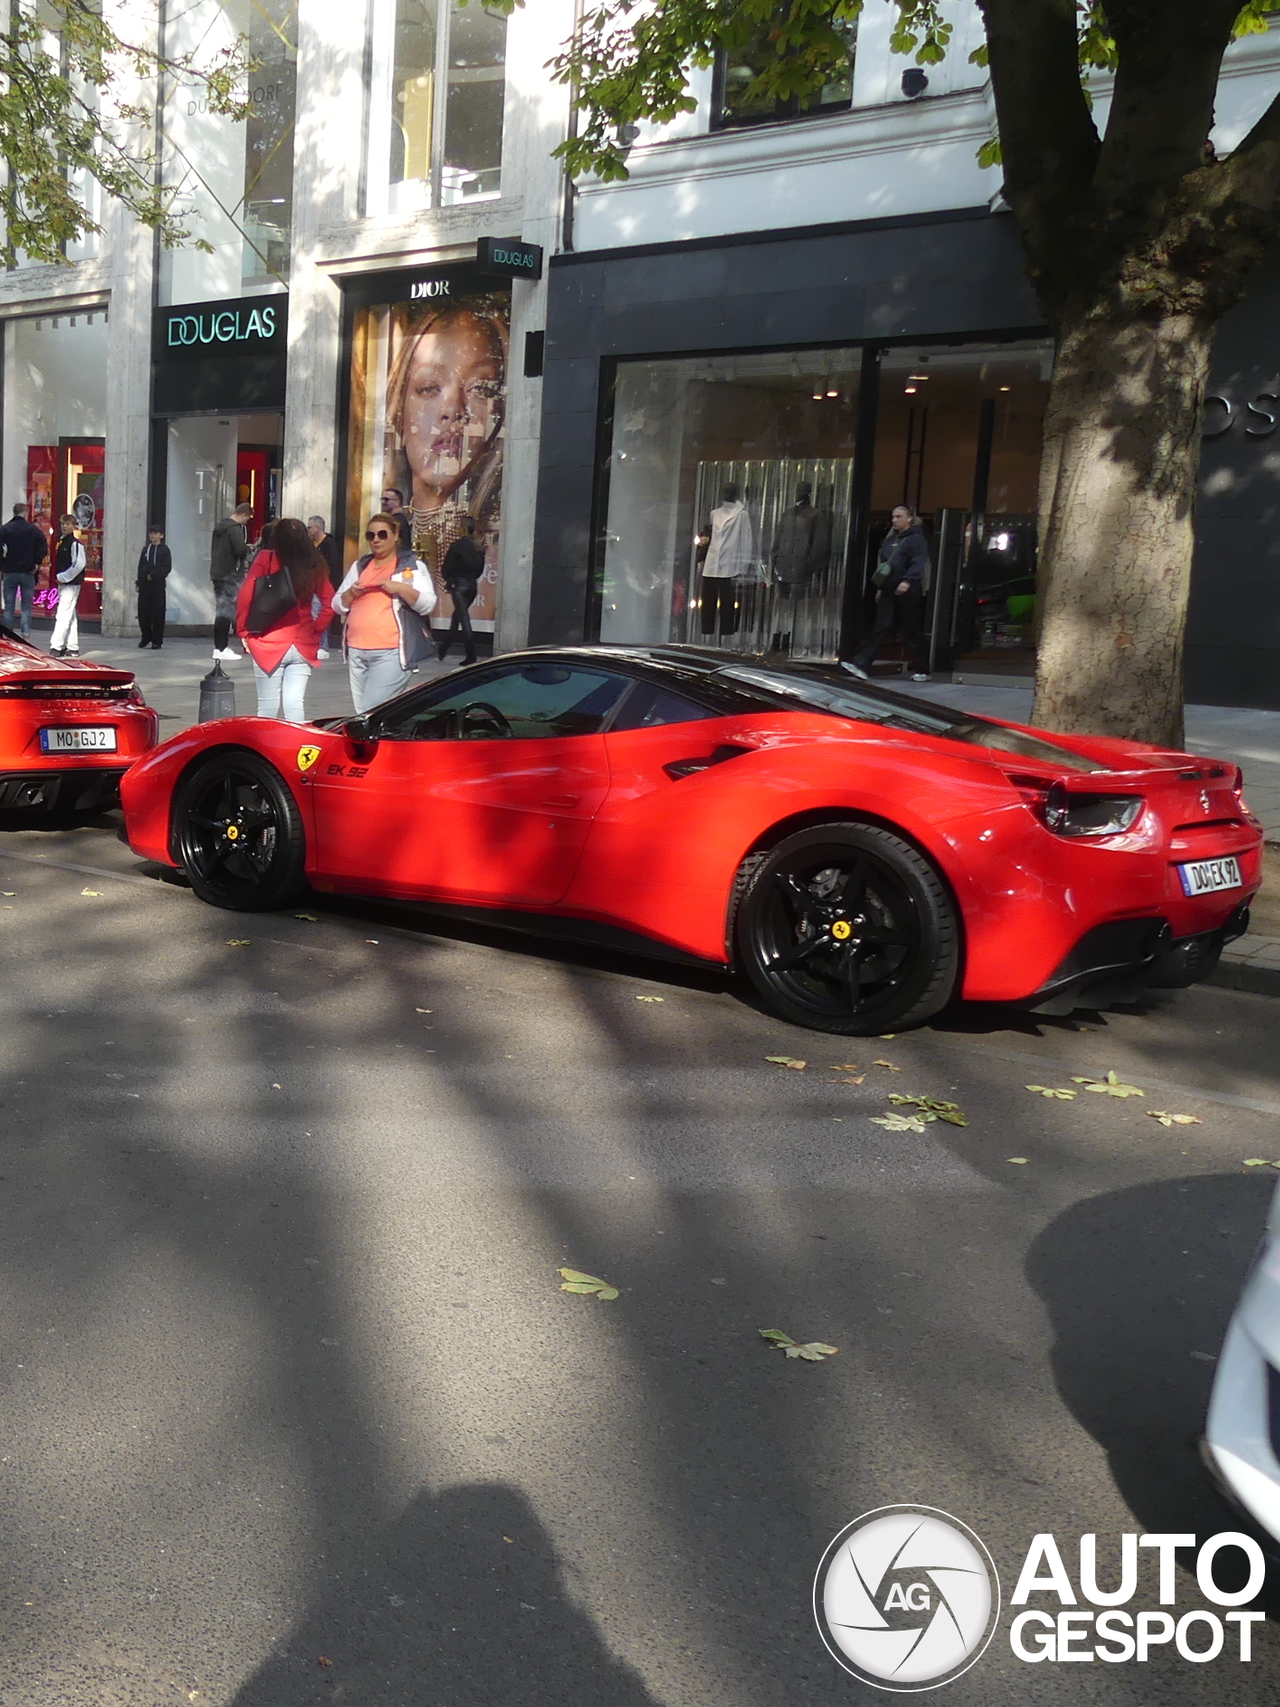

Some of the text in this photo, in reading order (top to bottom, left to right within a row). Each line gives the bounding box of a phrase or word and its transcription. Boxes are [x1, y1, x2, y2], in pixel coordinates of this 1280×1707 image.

[493, 249, 535, 268] DOUGLAS
[410, 280, 450, 299] DIOR
[168, 307, 276, 346] DOUGLAS
[1201, 395, 1280, 436] OS
[57, 732, 72, 746] MO
[81, 731, 96, 746] GJ
[99, 731, 106, 746] 2
[327, 764, 369, 778] EK 92
[1191, 858, 1239, 890] DO EK 92
